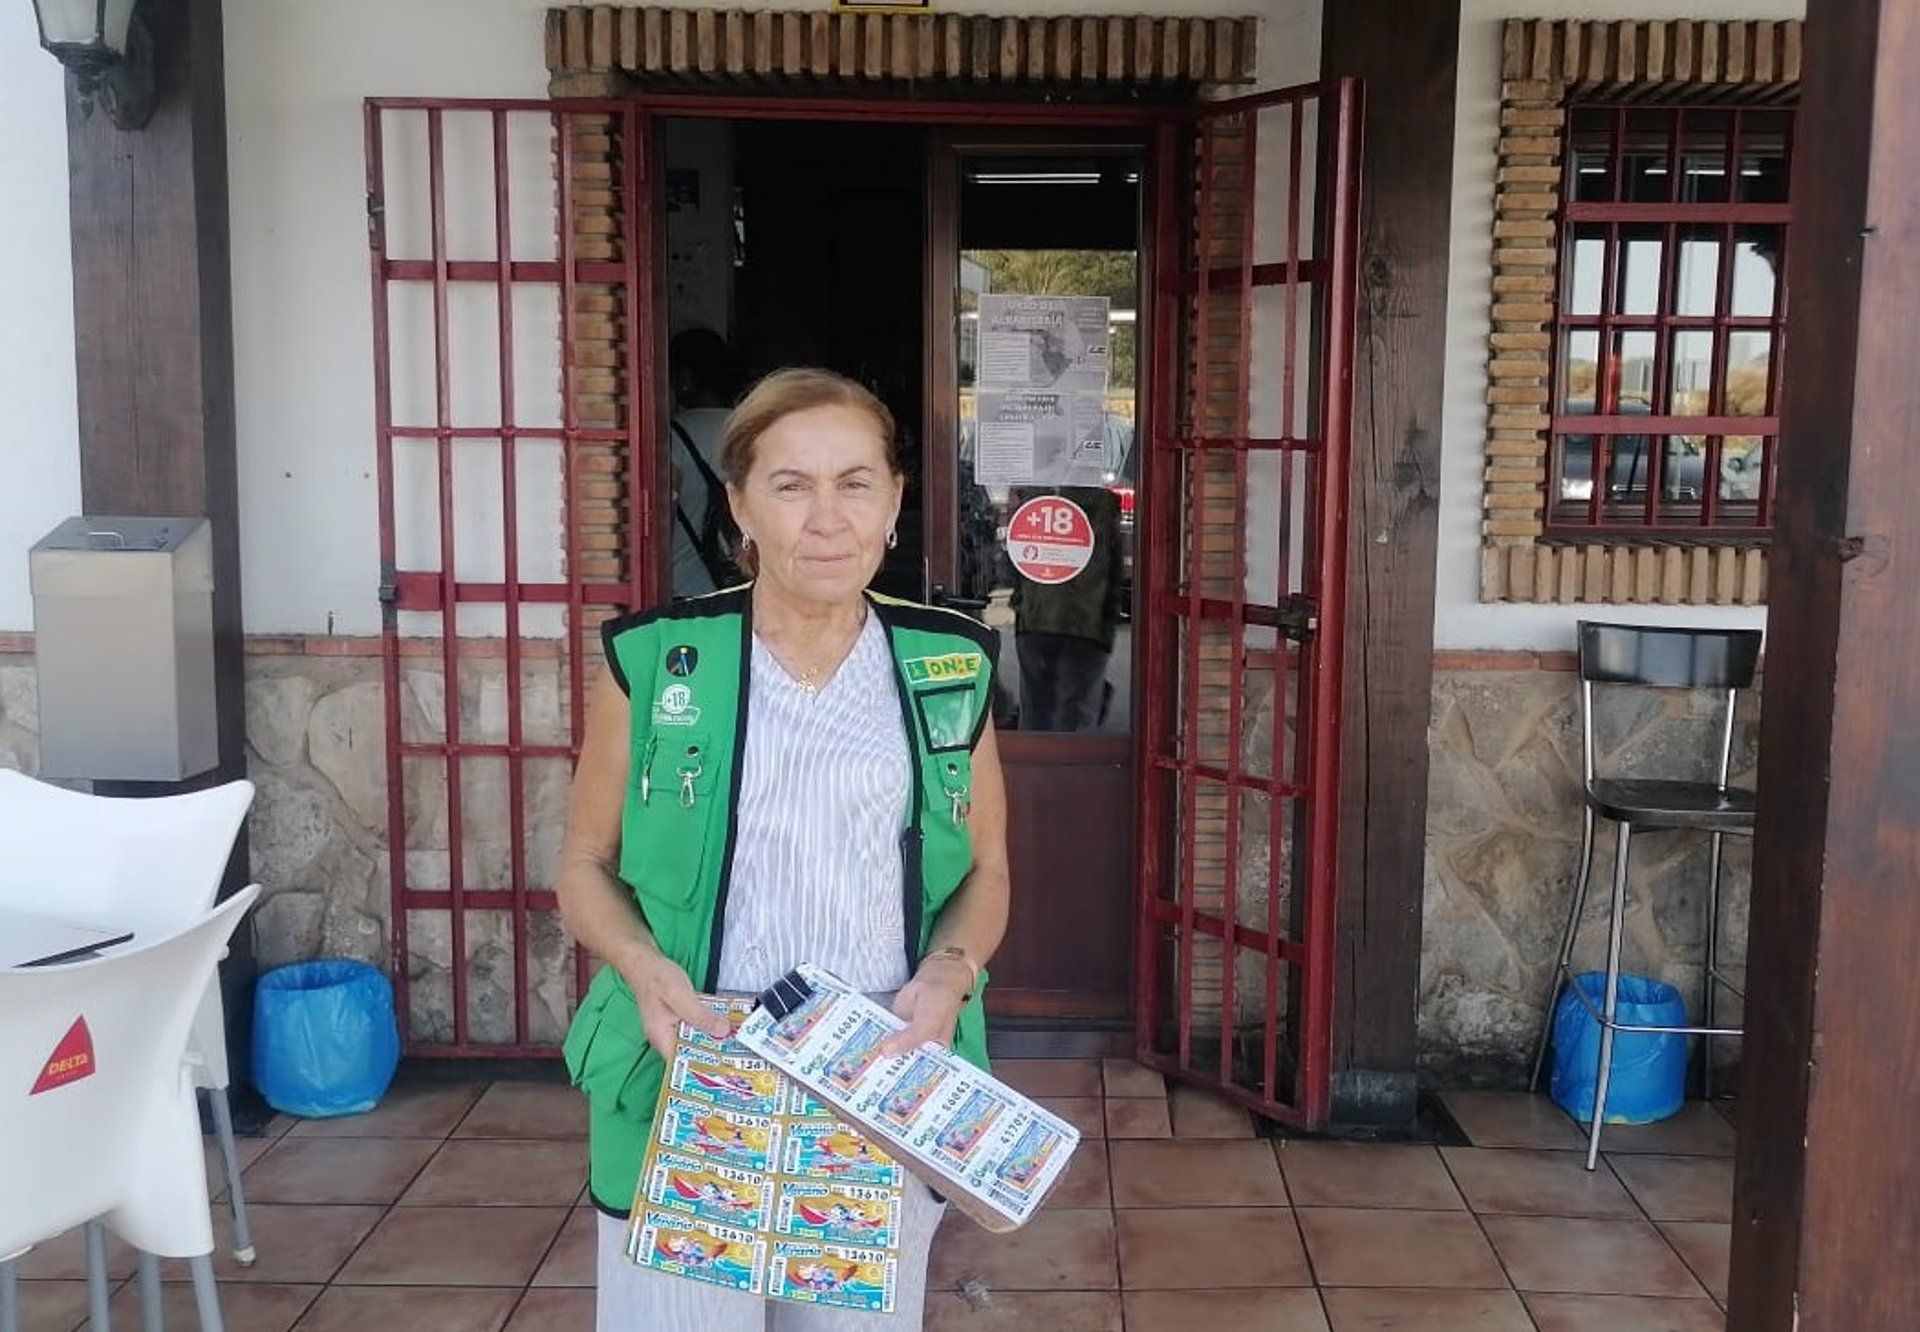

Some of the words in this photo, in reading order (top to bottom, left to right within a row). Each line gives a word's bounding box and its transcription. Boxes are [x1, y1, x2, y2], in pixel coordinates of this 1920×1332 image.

[1026, 506, 1073, 535] +18
[48, 1053, 88, 1075] DELTA
[732, 1113, 770, 1128] 13610
[723, 1170, 761, 1185] 13610
[782, 1183, 828, 1196] Verano
[850, 1186, 889, 1199] 13610
[713, 1226, 753, 1243] 13610
[844, 1247, 883, 1262] 13610
